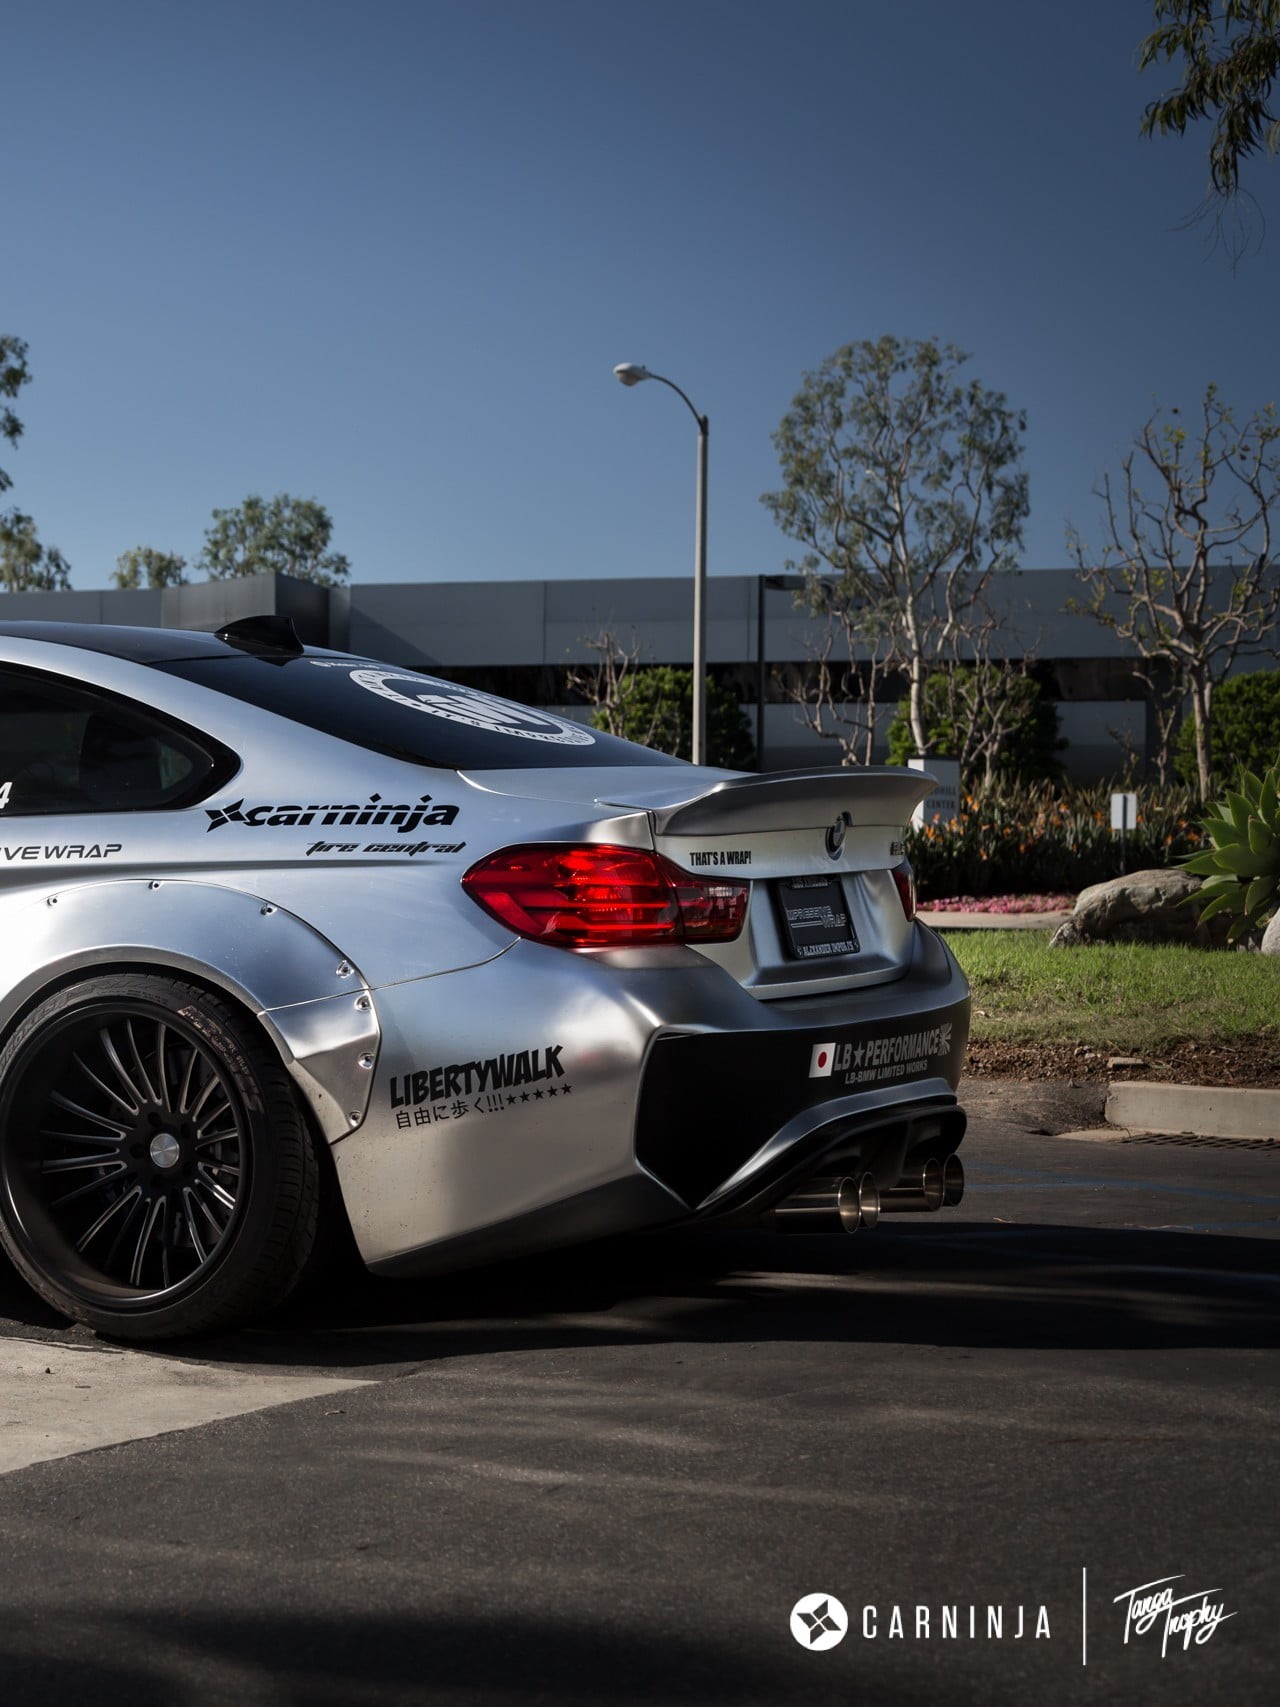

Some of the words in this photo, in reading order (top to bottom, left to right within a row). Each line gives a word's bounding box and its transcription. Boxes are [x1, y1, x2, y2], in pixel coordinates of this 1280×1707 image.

[244, 793, 460, 834] carninja
[689, 851, 719, 866] THAT'S
[720, 851, 726, 866] A
[726, 850, 752, 865] WRAP!
[864, 1028, 940, 1066] PERFORMANCE
[390, 1045, 566, 1109] LIBERTYWALK
[845, 1068, 877, 1085] LB-BMW
[877, 1063, 905, 1080] LIMITED
[906, 1059, 928, 1074] WORKS
